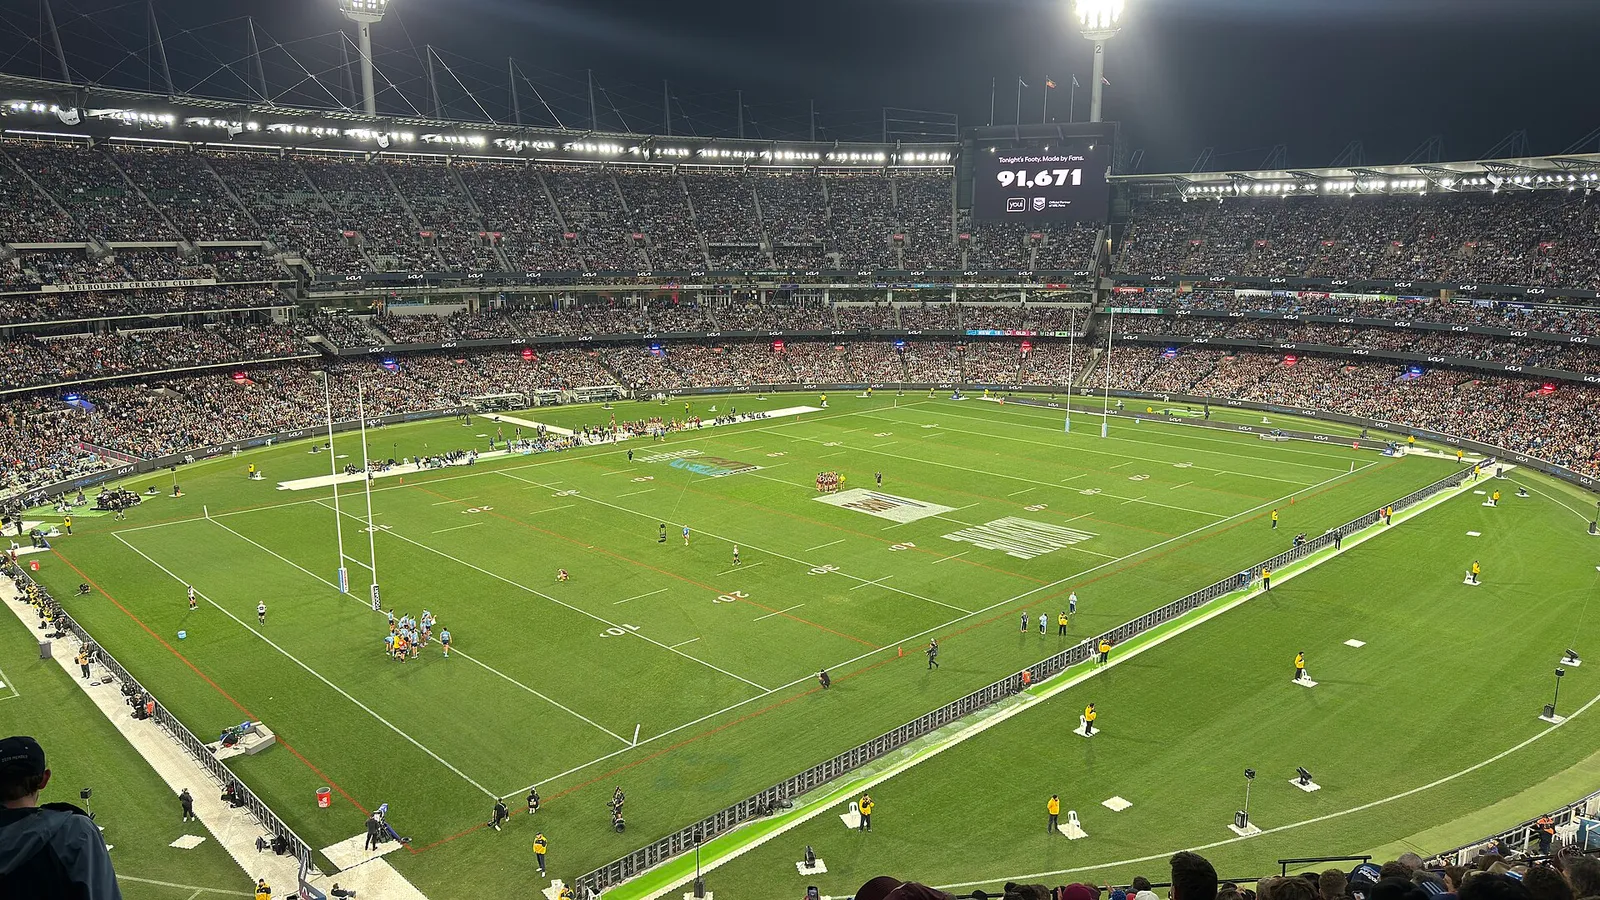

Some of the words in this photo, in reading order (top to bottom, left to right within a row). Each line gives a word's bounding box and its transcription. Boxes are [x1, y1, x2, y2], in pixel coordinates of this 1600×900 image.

[363, 27, 368, 37] 1
[1095, 45, 1101, 53] 2
[999, 156, 1024, 164] Tonight's
[997, 169, 1082, 188] 91,671
[69, 282, 124, 291] MELBOURNE
[129, 280, 168, 288] CRICKET
